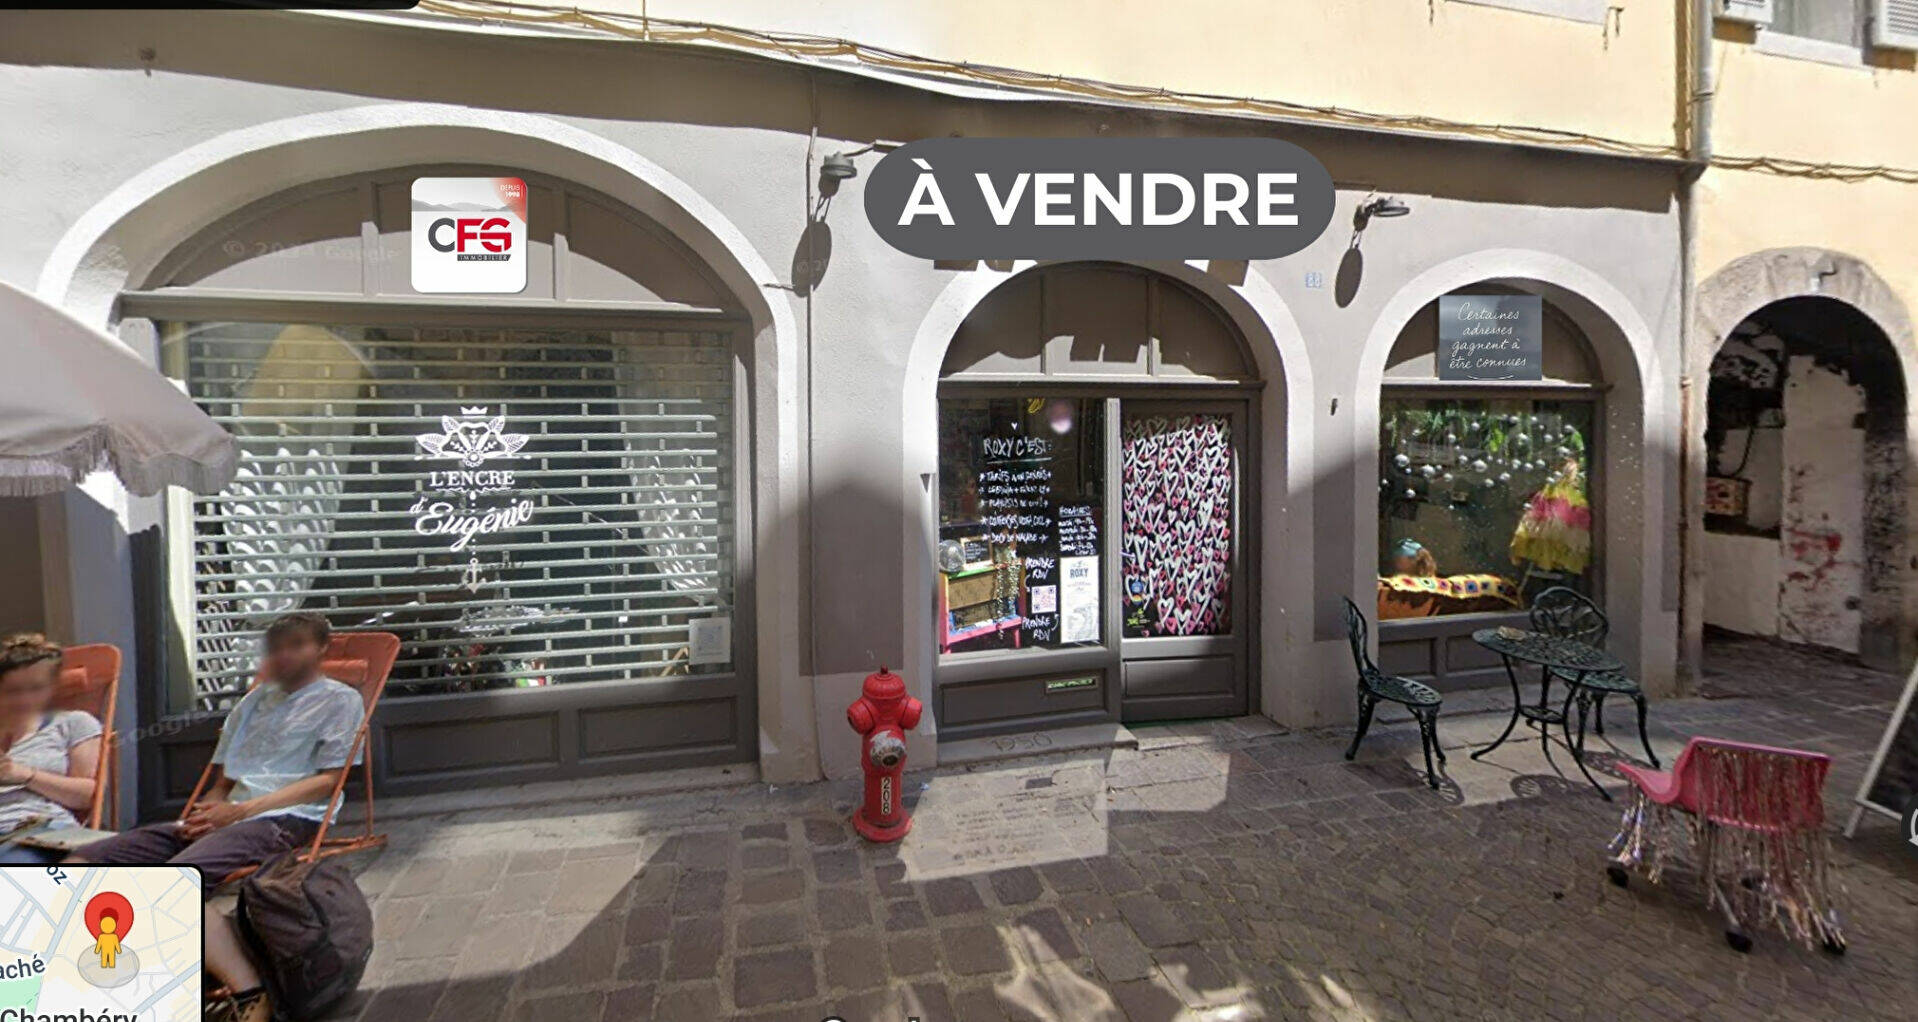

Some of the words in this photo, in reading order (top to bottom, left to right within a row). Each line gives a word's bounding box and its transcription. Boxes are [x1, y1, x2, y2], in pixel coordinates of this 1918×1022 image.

[983, 437, 1014, 459] ROXY
[429, 470, 516, 487] L'ENCRE
[1070, 568, 1088, 579] ROXY
[882, 776, 891, 815] 208
